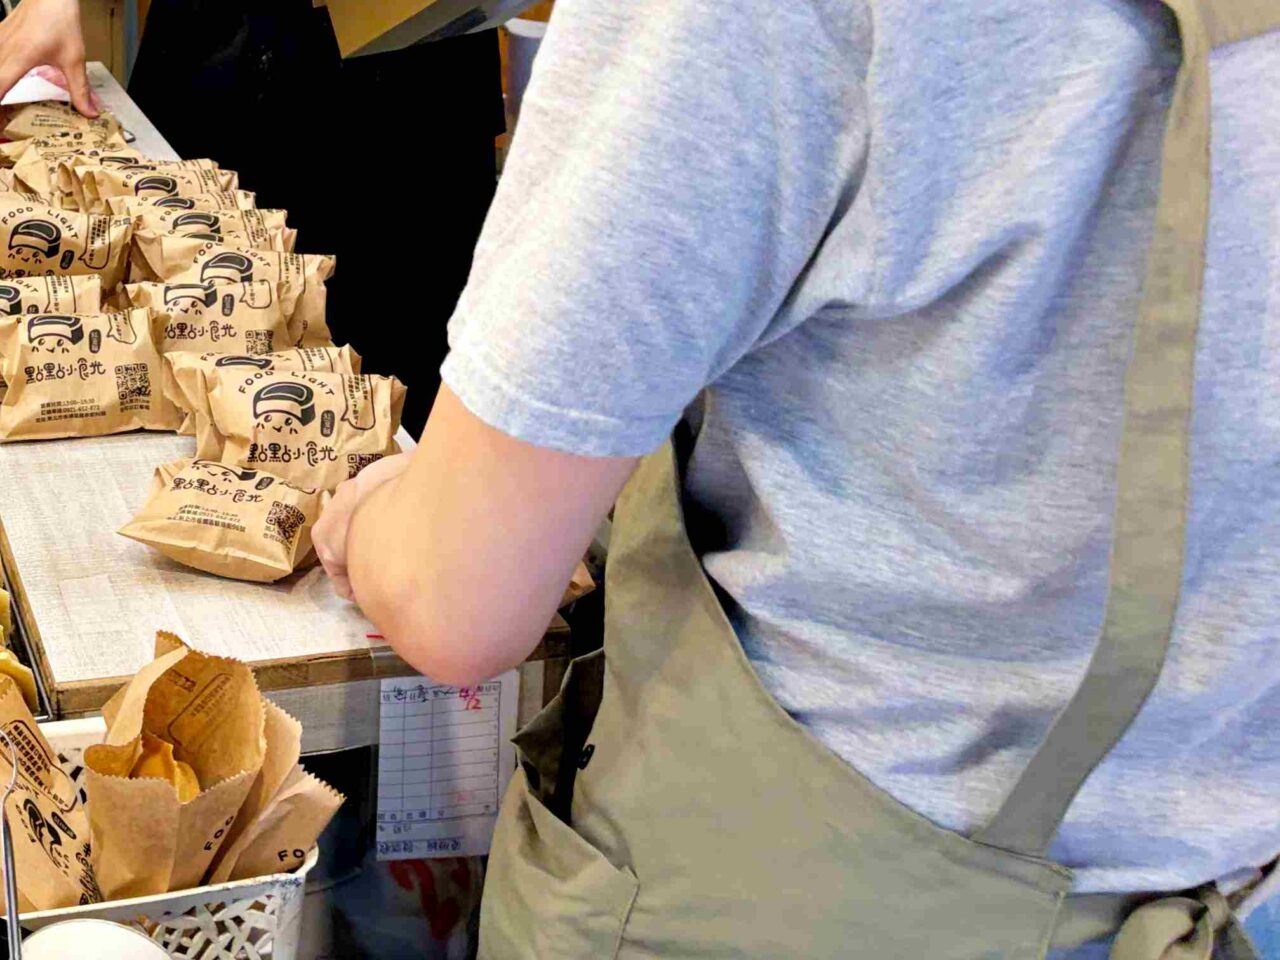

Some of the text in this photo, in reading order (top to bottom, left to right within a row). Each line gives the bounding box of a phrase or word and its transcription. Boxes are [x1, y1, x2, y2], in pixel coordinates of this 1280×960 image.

[1, 206, 79, 240] FOOD LIGHT
[236, 246, 271, 268] LIGHT
[238, 370, 335, 396] FOOD LIGHT
